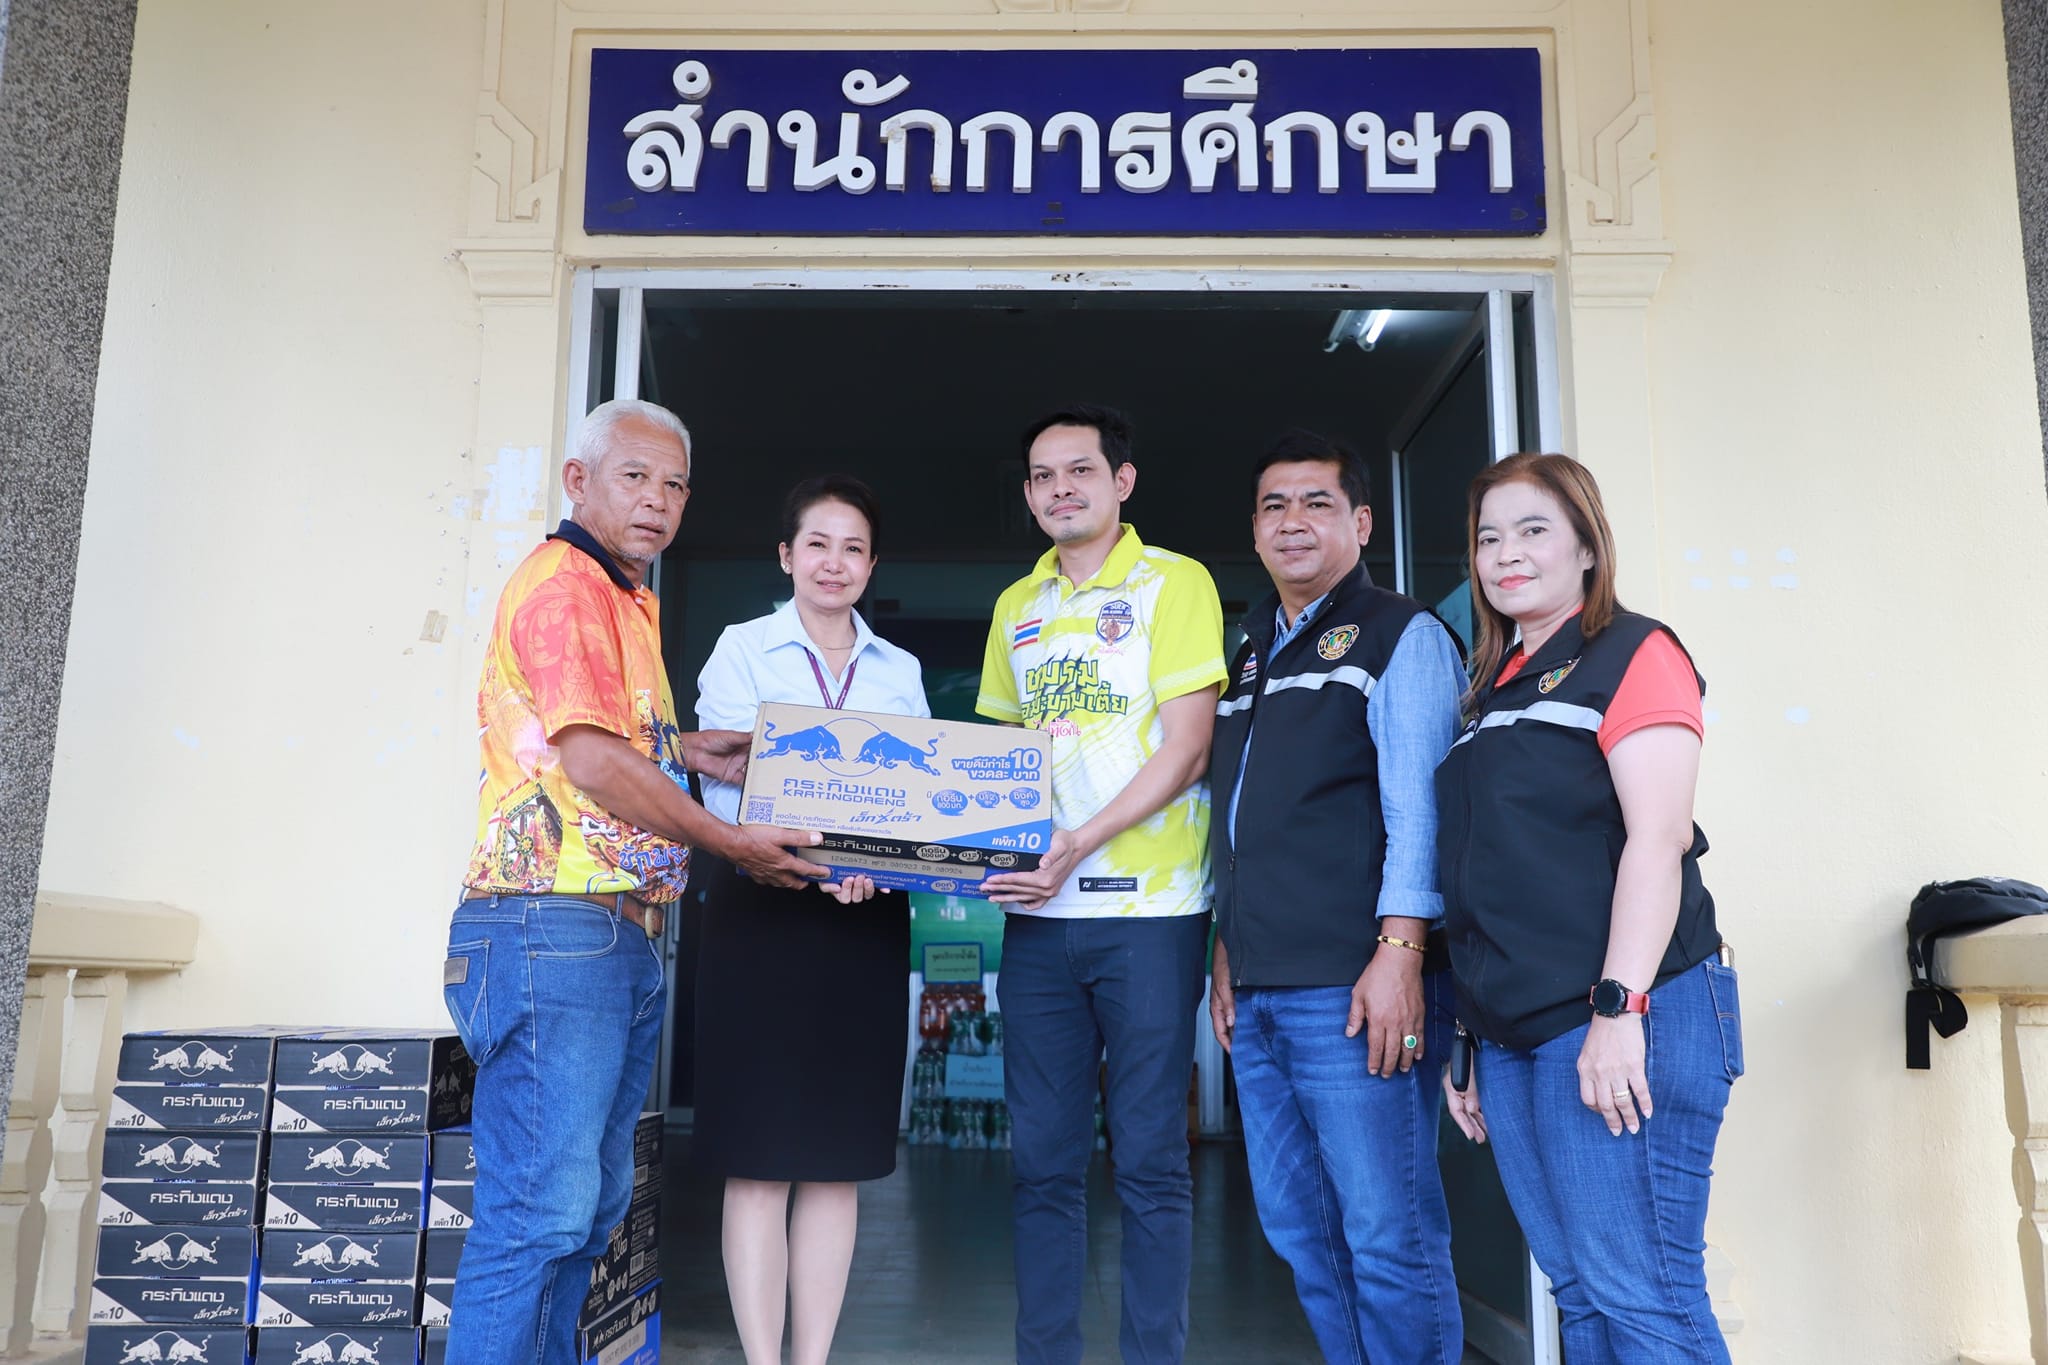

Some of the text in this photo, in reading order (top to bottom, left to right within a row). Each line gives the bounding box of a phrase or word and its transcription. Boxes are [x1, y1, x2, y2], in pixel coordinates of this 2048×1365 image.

[624, 59, 1514, 195] สำนักการศึกษา
[1011, 749, 1040, 770] 10
[970, 769, 1038, 780] ขวดละ บาท
[783, 778, 906, 798] กระทิงแดง
[783, 788, 906, 807] KRATINGDAENG
[823, 840, 902, 854] ระทิงแดง
[992, 832, 1041, 849] แพ็ก 10
[162, 1093, 245, 1108] กระทิงแดง
[323, 1096, 406, 1111] กระทิงแดง
[131, 1114, 146, 1127] 10
[293, 1118, 308, 1131] 10
[150, 1189, 234, 1205] กระทิงแดง
[316, 1193, 400, 1209] กระทิงแดง
[118, 1211, 134, 1224] 10
[283, 1212, 299, 1225] 10
[449, 1214, 464, 1227] 10
[141, 1288, 225, 1303] กระทิงแดง
[309, 1290, 393, 1305] กระทิงแดง
[108, 1307, 124, 1320] 10
[278, 1313, 293, 1326] 10
[443, 1313, 451, 1326] 1
